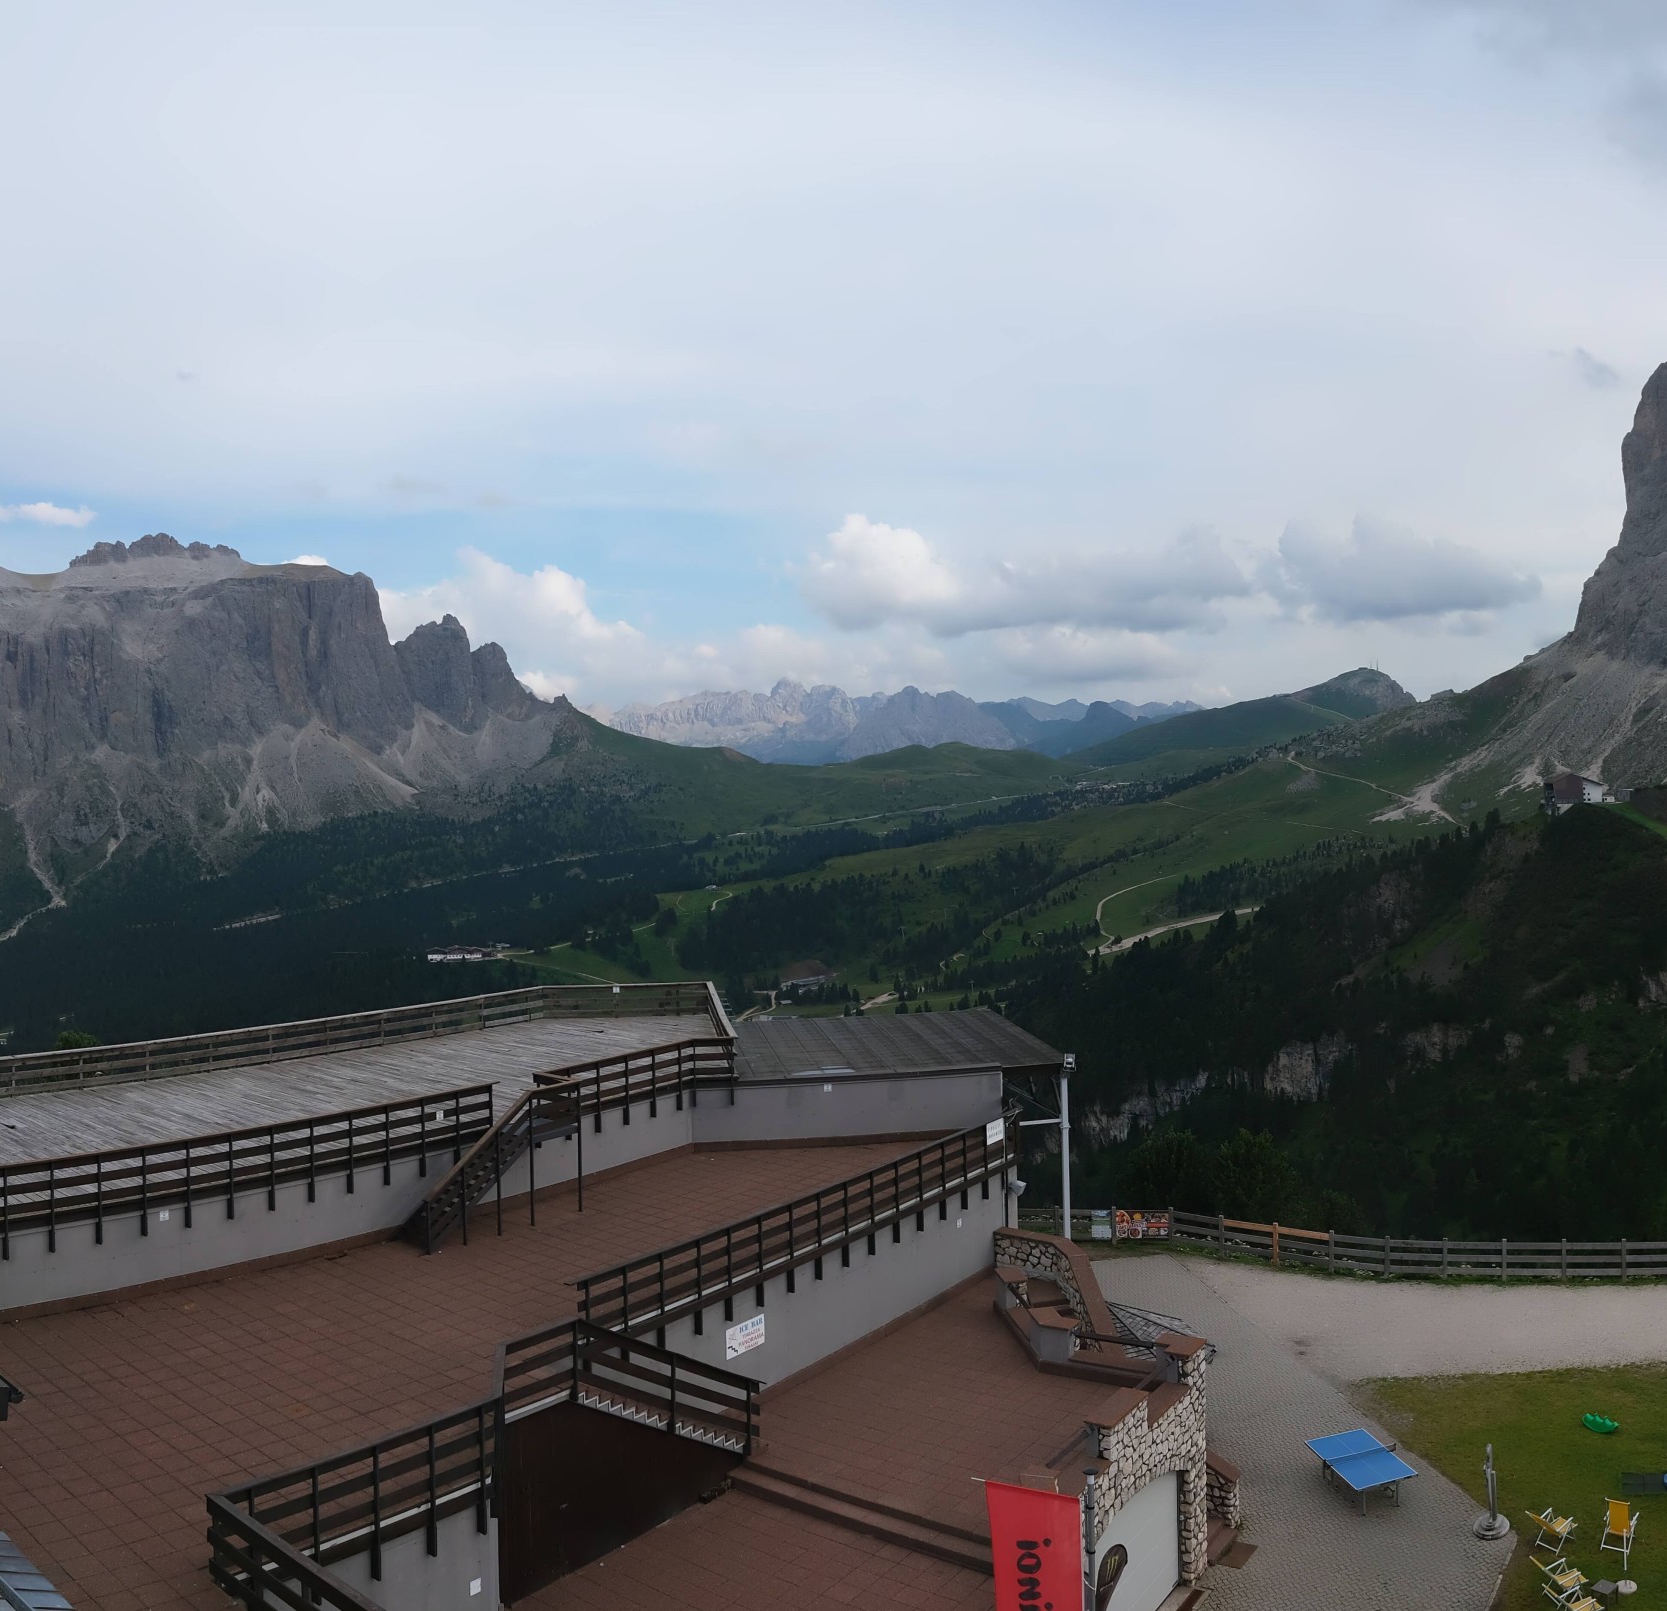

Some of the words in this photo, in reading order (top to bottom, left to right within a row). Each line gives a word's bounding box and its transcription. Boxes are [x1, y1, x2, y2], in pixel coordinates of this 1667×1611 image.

[739, 1323, 749, 1333] ICE
[751, 1318, 763, 1328] BAR
[739, 1332, 764, 1347] PANORAMA
